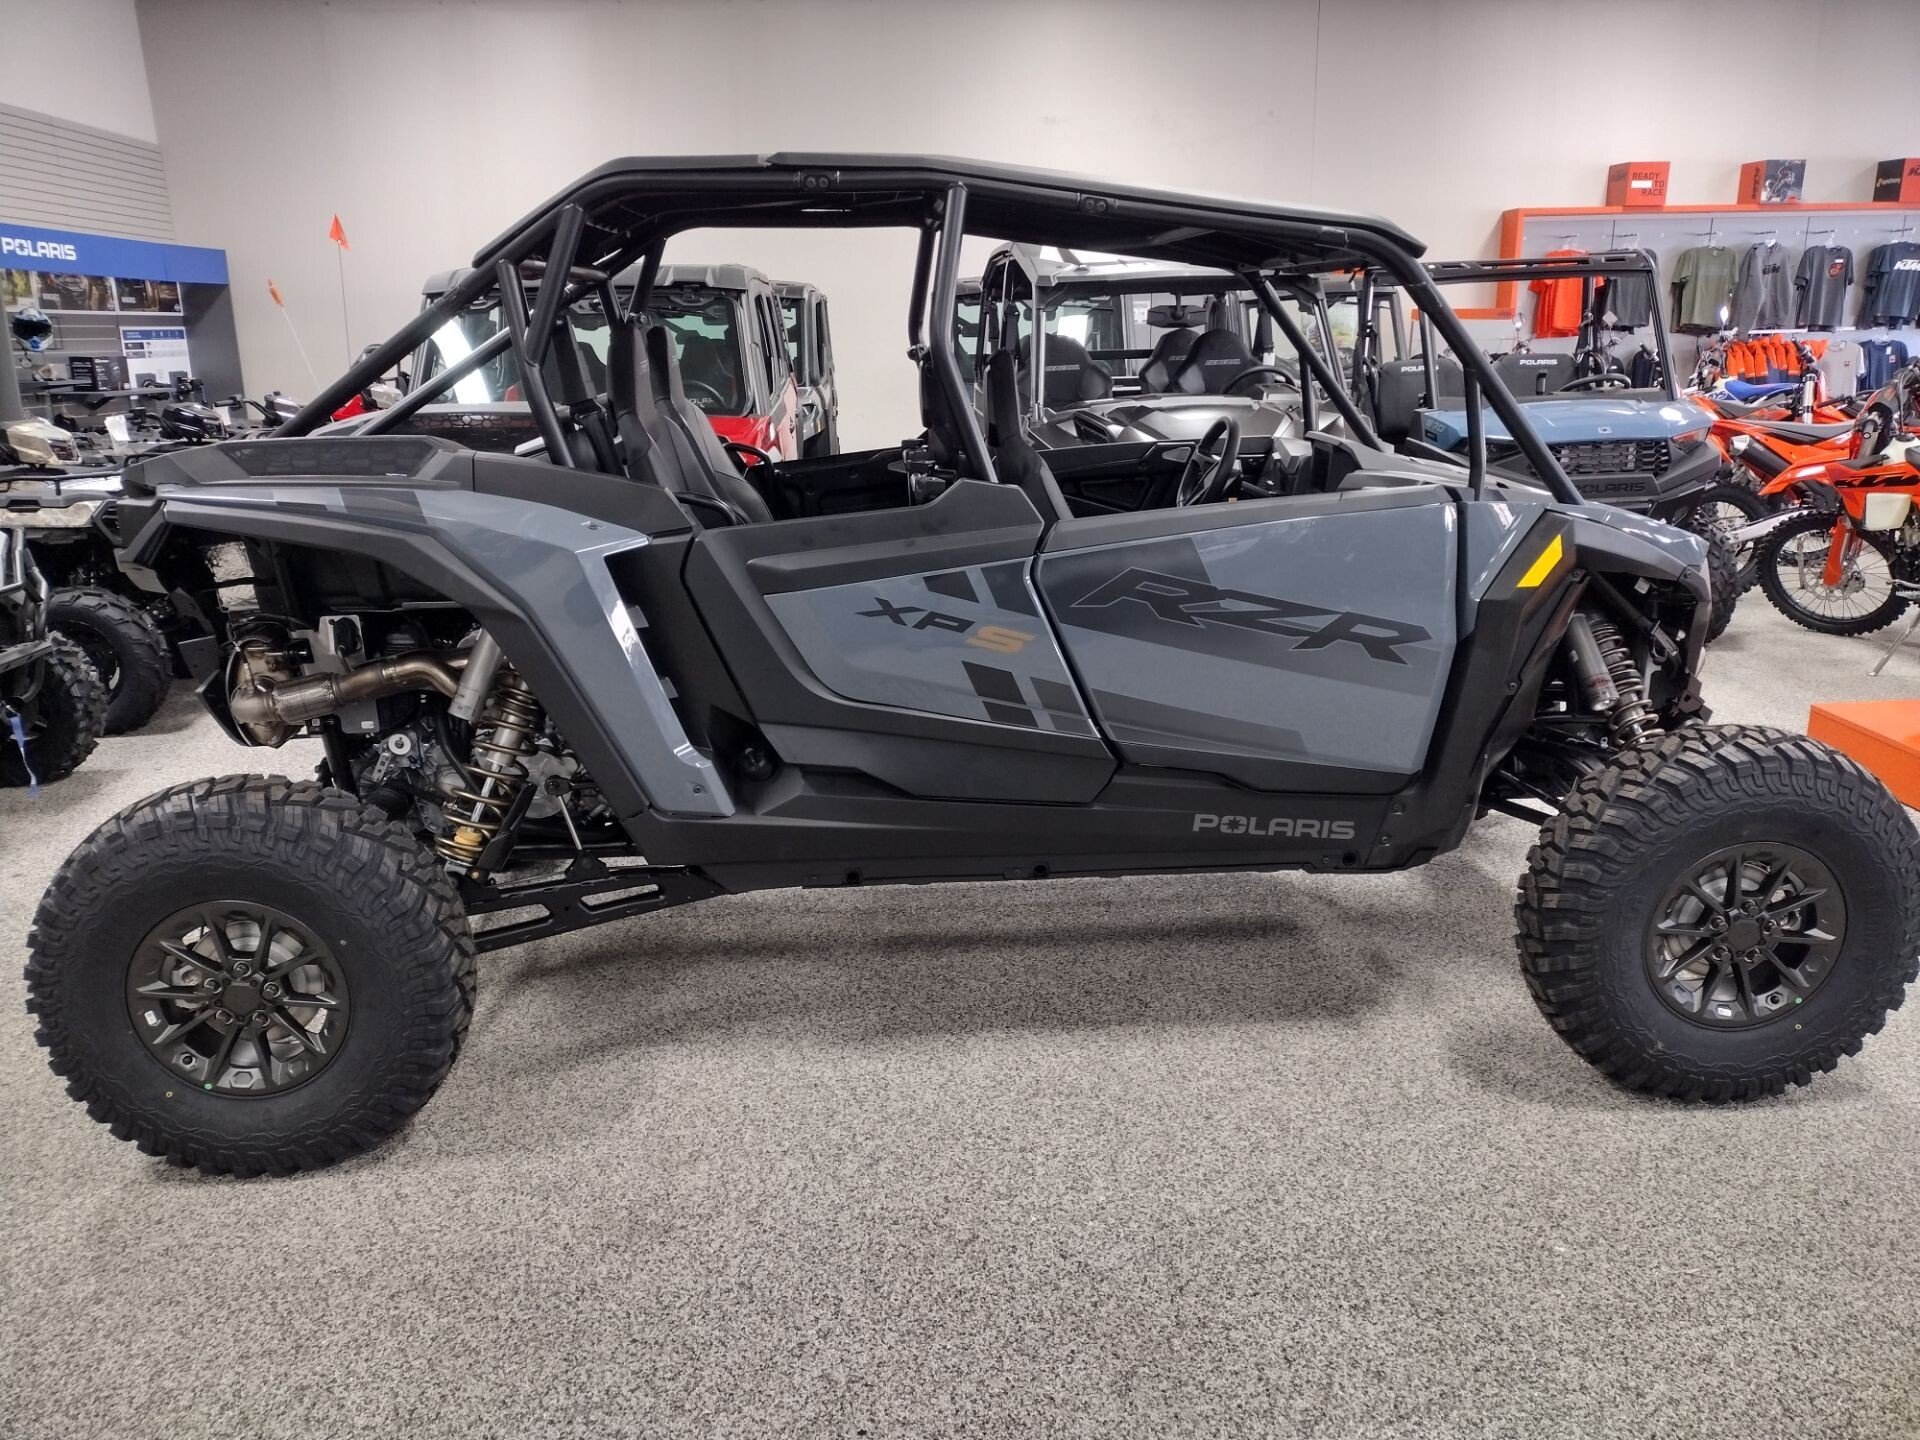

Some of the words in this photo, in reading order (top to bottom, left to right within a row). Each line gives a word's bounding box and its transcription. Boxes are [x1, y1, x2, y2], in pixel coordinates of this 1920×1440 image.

[1632, 172, 1660, 180] READY
[1641, 189, 1664, 197] RACE
[1, 237, 77, 260] POLARIS
[1070, 566, 1433, 667] RZR
[1192, 813, 1355, 840] POLARIS
